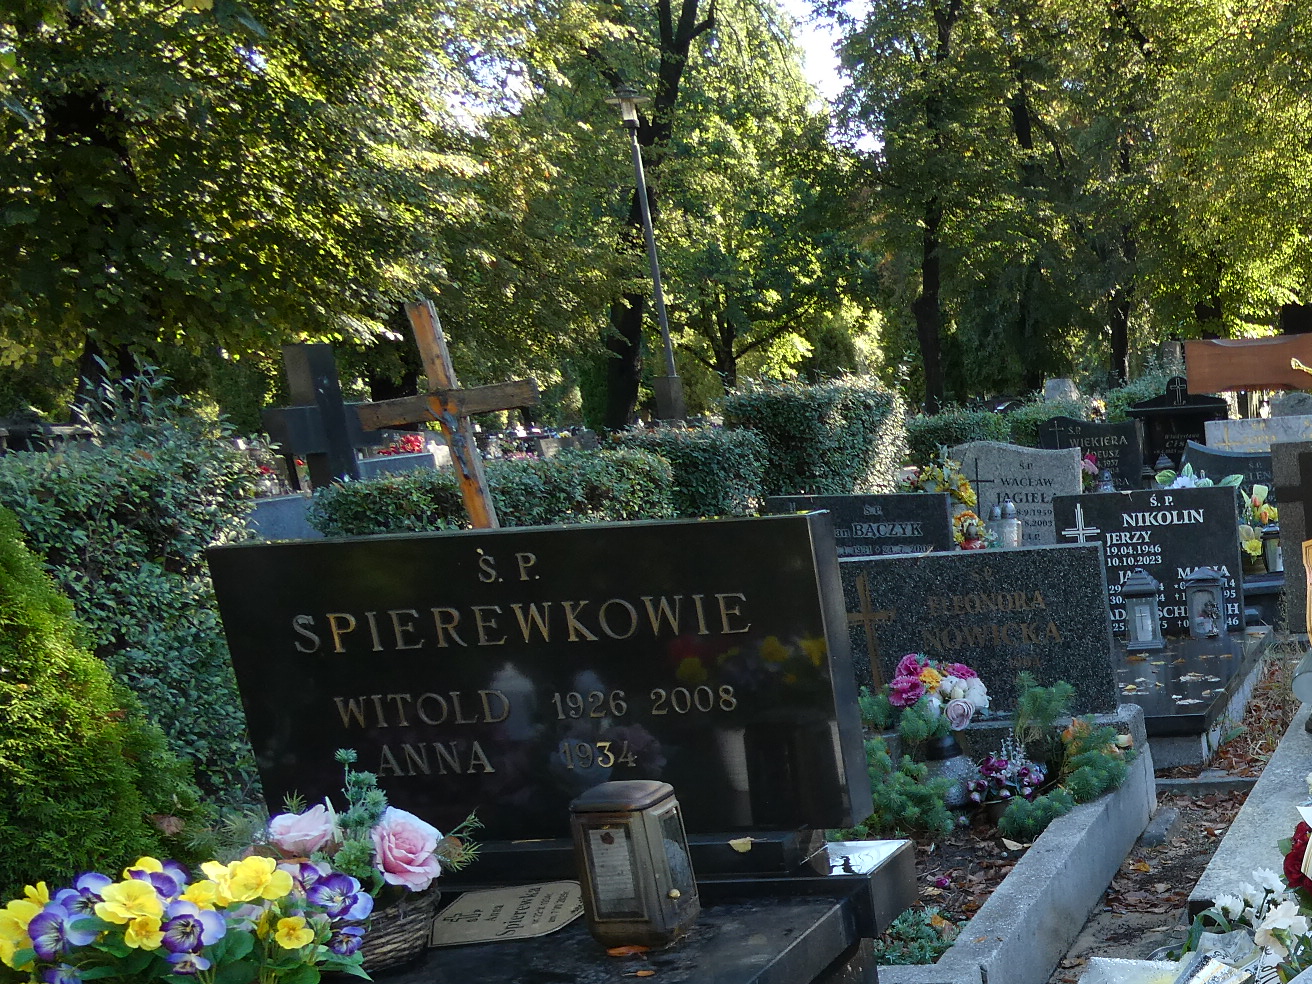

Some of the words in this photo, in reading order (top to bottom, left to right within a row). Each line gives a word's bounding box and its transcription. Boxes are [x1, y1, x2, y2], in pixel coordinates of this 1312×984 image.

[1069, 435, 1128, 447] WIEKIERA
[1121, 509, 1204, 528] NIKOLIN
[852, 521, 923, 538] BĄCZYK
[1105, 530, 1152, 547] JERZY
[1106, 545, 1162, 556] 19.04.1946
[1107, 555, 1162, 567] 10.10.2023
[293, 592, 751, 655] SPIEREWKOWIE
[921, 620, 1063, 650] NOWICKA
[334, 689, 511, 729] WITOLD
[551, 690, 628, 721] 1926
[651, 685, 738, 716] 2008
[378, 740, 497, 778] ANNA
[562, 739, 638, 770] 1934
